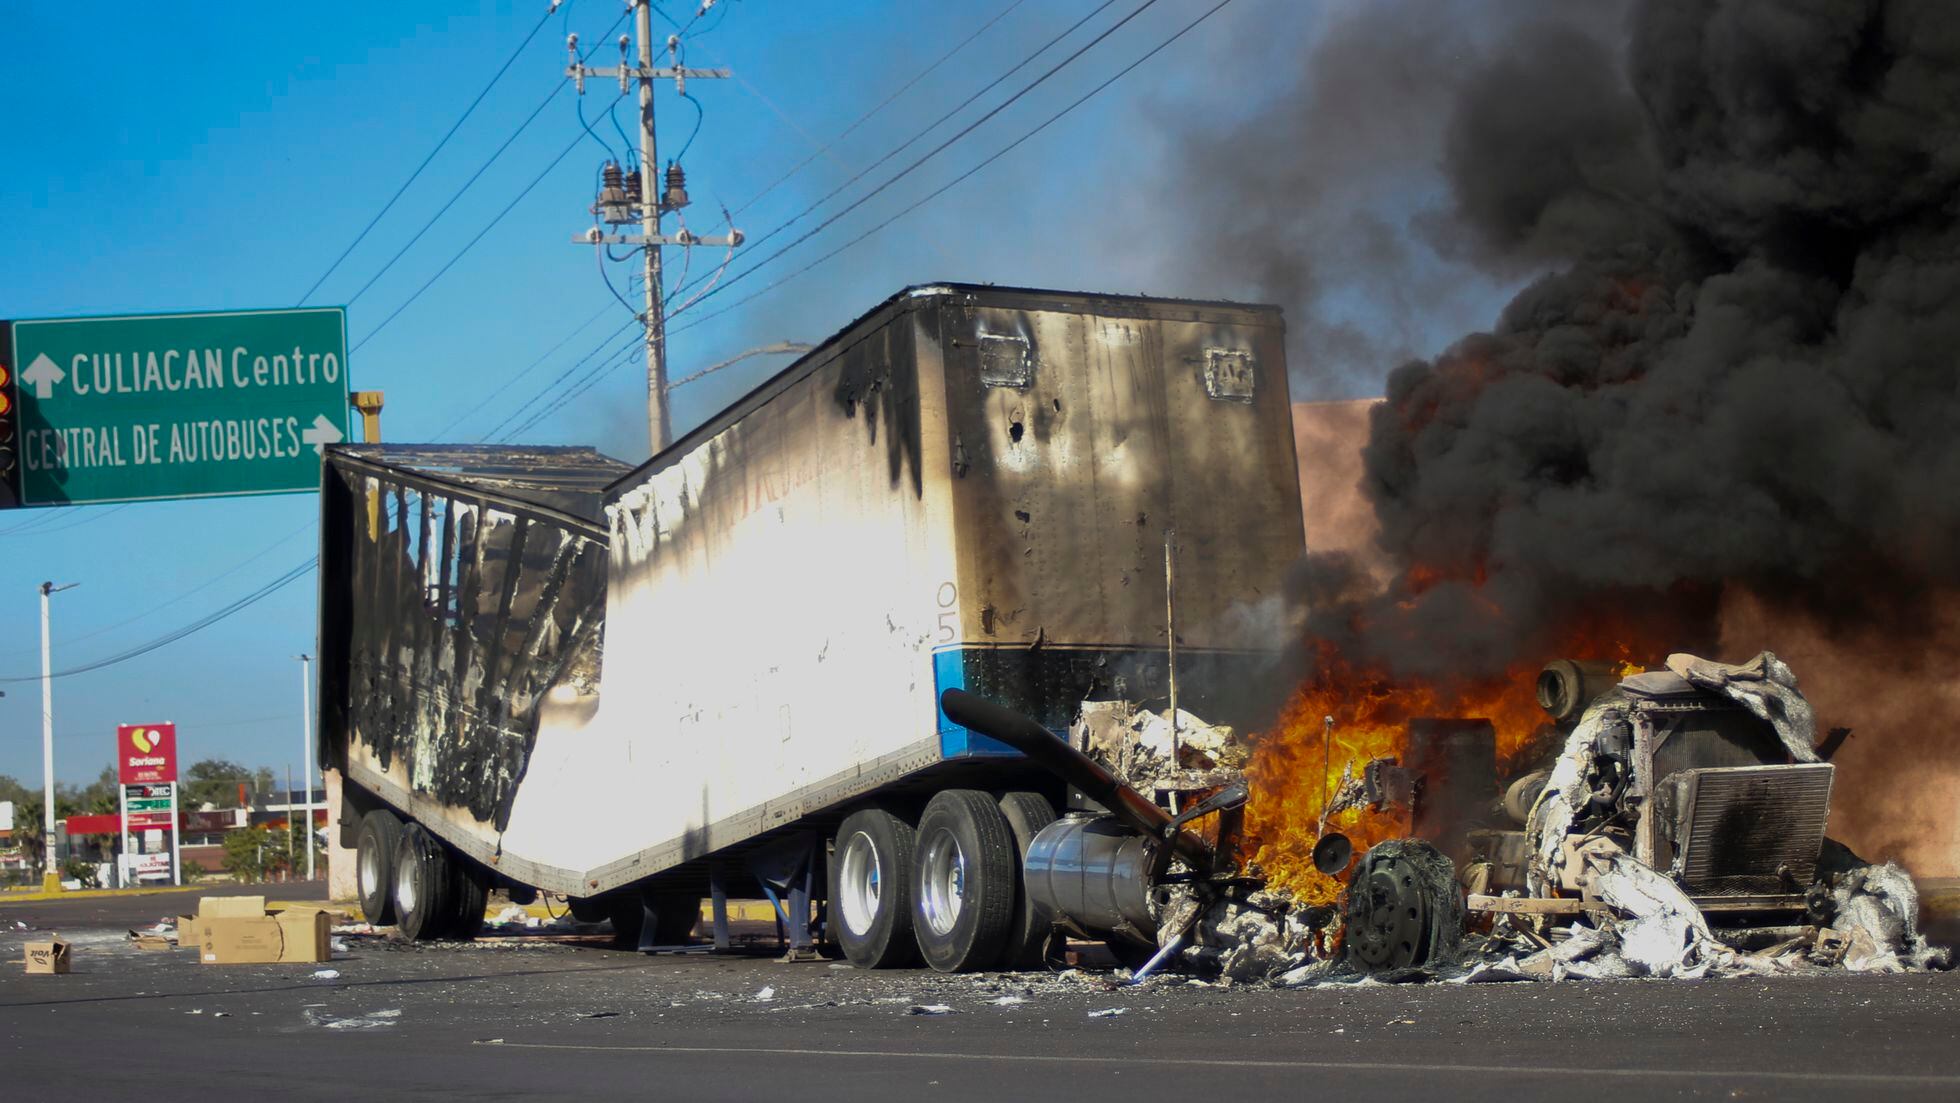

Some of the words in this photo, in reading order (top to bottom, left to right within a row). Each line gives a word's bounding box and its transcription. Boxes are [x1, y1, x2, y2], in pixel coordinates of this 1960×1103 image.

[71, 349, 224, 395] CULIACAN
[232, 347, 340, 386] Centro
[27, 426, 126, 470] CENTRAL
[134, 424, 161, 465] DE
[170, 417, 299, 463] AUTOBUSES
[129, 757, 165, 767] Soriana
